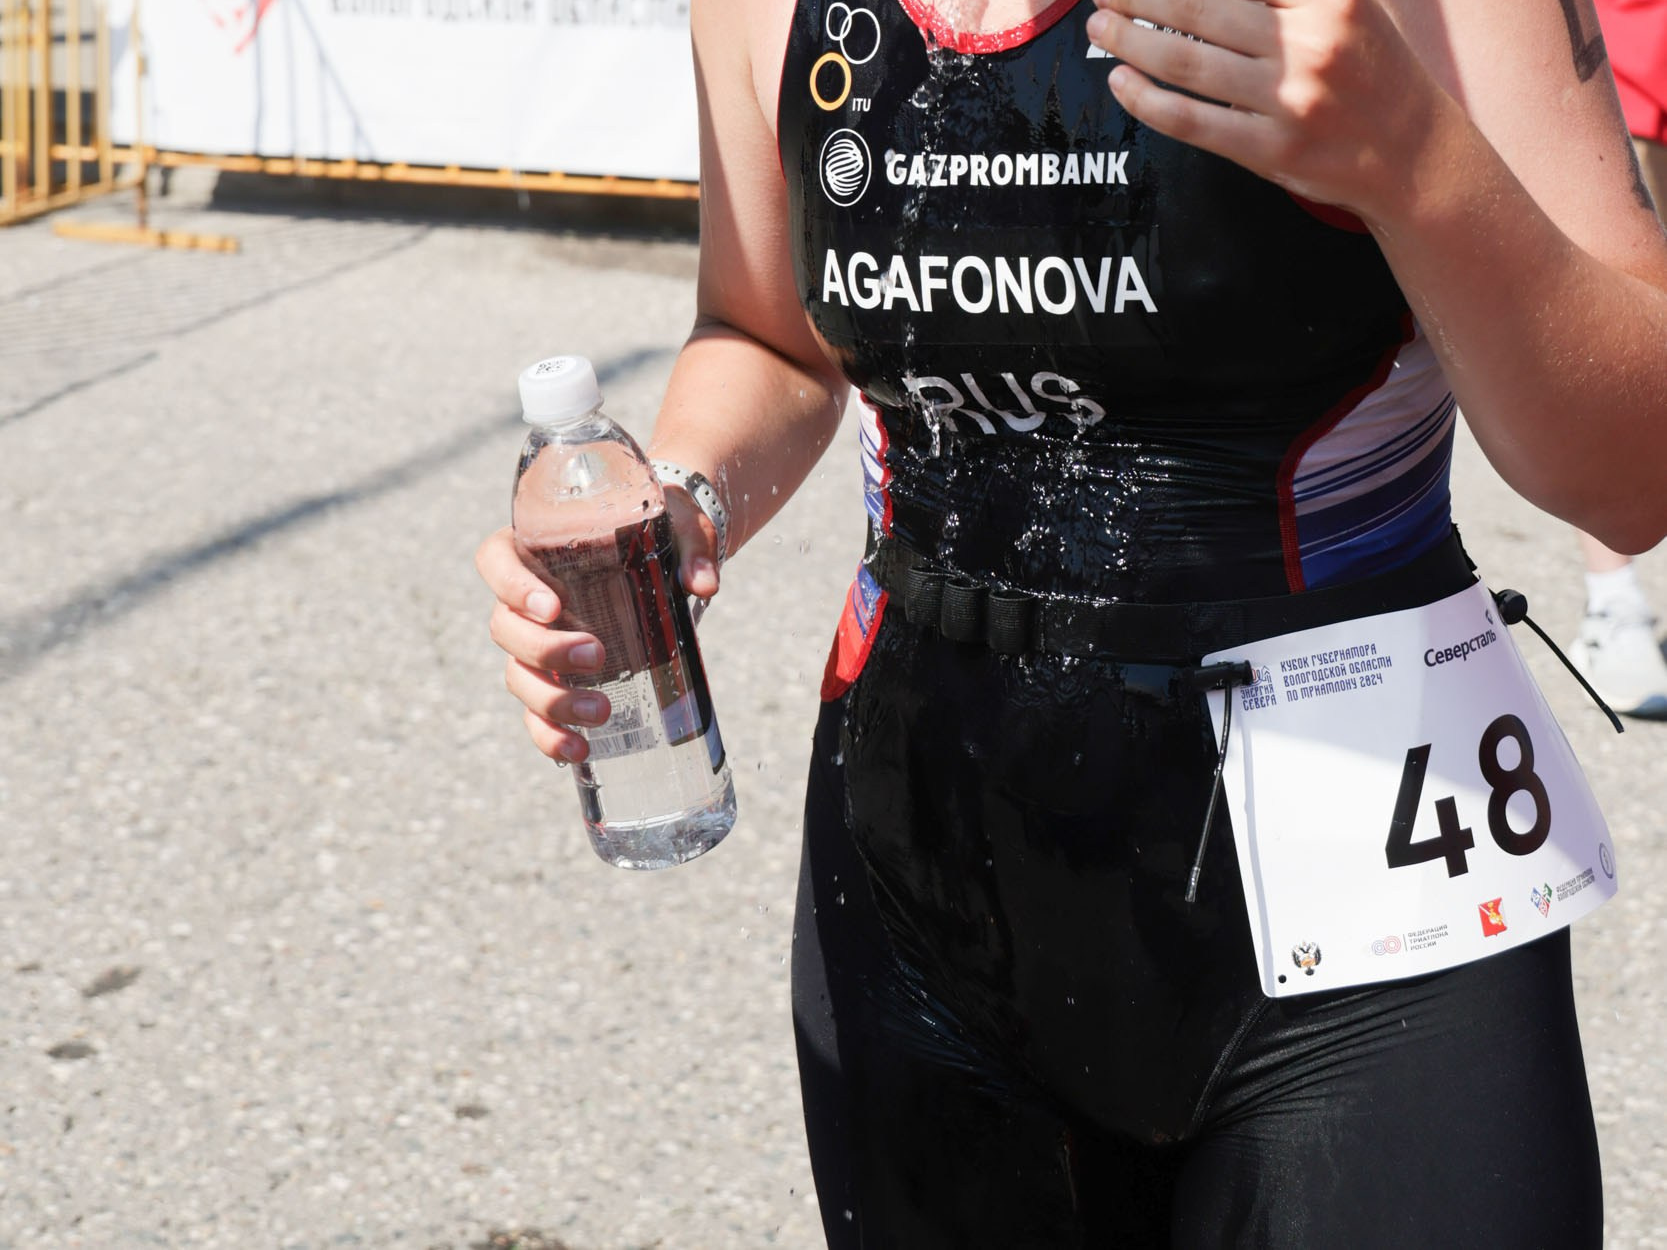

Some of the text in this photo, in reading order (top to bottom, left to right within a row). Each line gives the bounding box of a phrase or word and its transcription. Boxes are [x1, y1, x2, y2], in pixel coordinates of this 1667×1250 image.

[852, 97, 871, 112] ITU
[886, 151, 1129, 187] GAZPROMBANK
[822, 248, 1158, 315] AGAFONOVA
[901, 371, 1106, 435] RUS
[1280, 643, 1377, 673] КУБОК ГУБЕРНАТОРА
[1424, 629, 1497, 667] Северсталь
[1283, 656, 1393, 688] ВОЛОГОДСКОЙ ОБЛАСТИ
[1286, 673, 1384, 702] ПО ТРИАТЛОНУ 2024
[1240, 684, 1275, 699] ЭНЕРГИЯ
[1242, 694, 1277, 711] СЕВЕРА
[1384, 713, 1552, 879] 48
